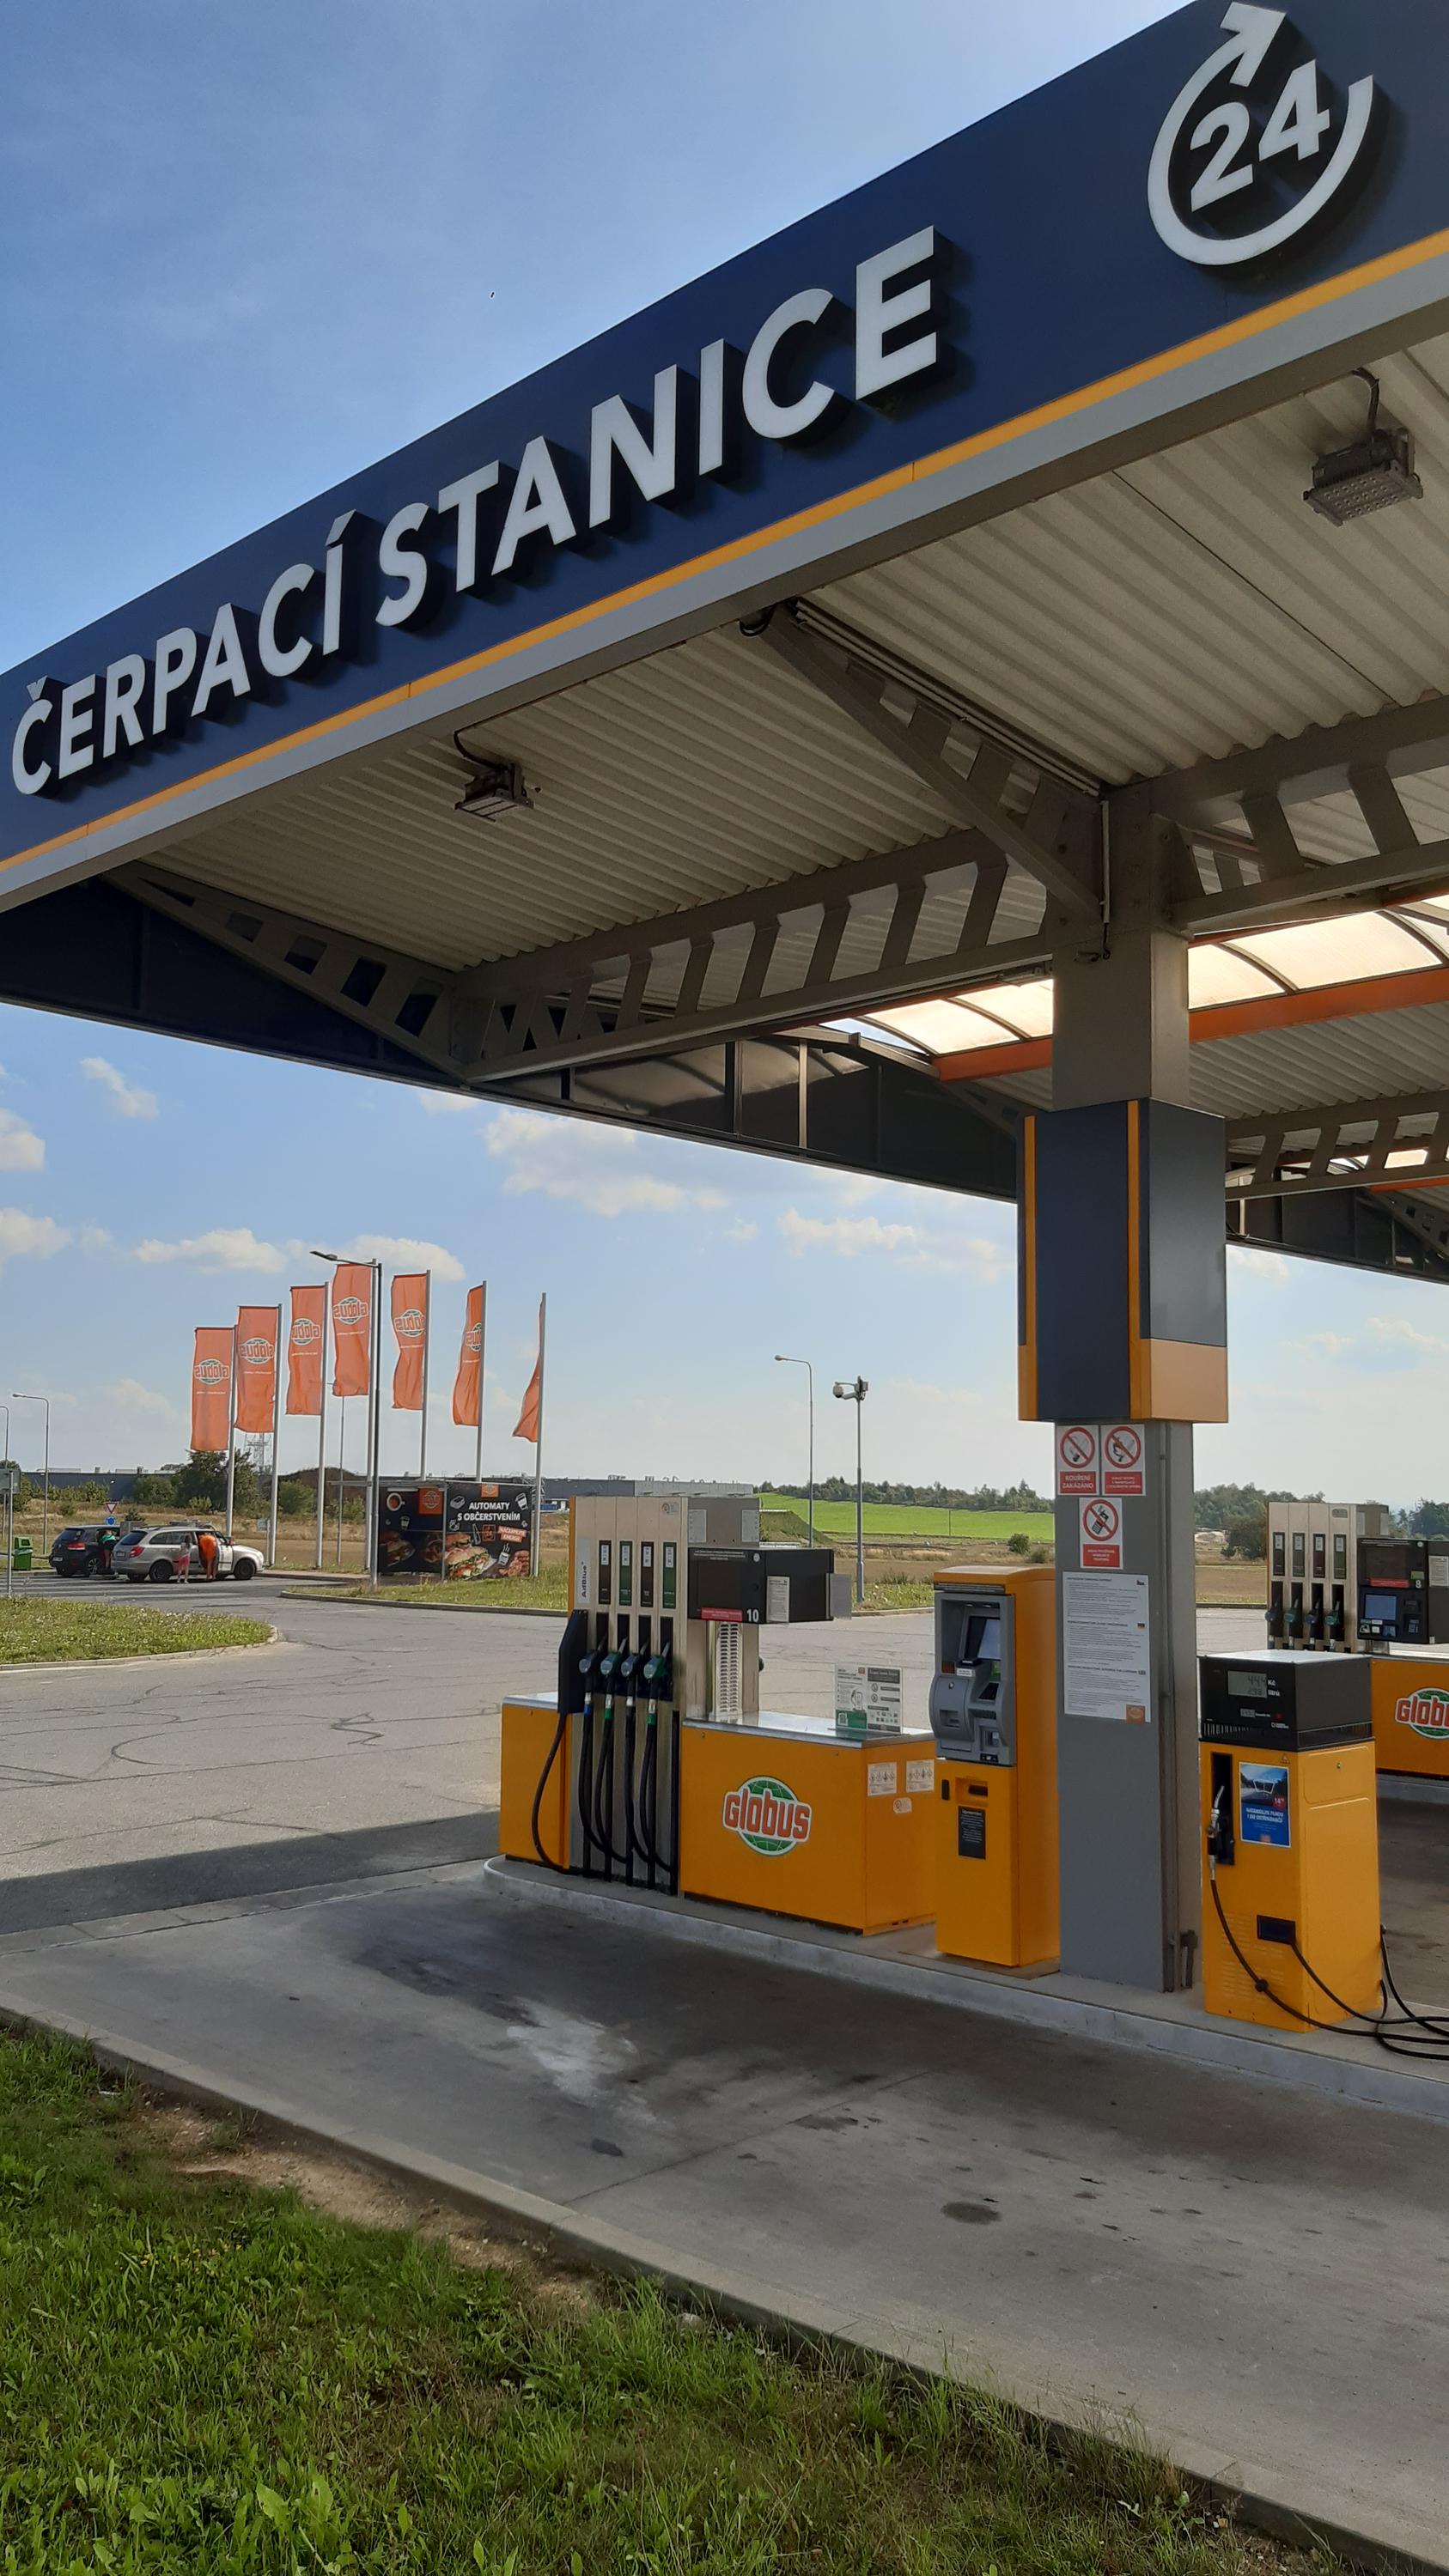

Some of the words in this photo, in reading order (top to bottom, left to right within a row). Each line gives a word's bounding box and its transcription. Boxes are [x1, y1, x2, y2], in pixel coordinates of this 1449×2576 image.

[1190, 58, 1330, 212] 24
[11, 508, 357, 796] ČERPACÍ
[375, 225, 938, 629] STANICE
[457, 1512, 463, 1521] S
[464, 1511, 521, 1521] OBČERSTVENÍM
[1415, 1579, 1422, 1589] 8
[746, 1608, 759, 1622] 10
[1397, 1695, 1449, 1727] Glob
[724, 1789, 811, 1840] Globus
